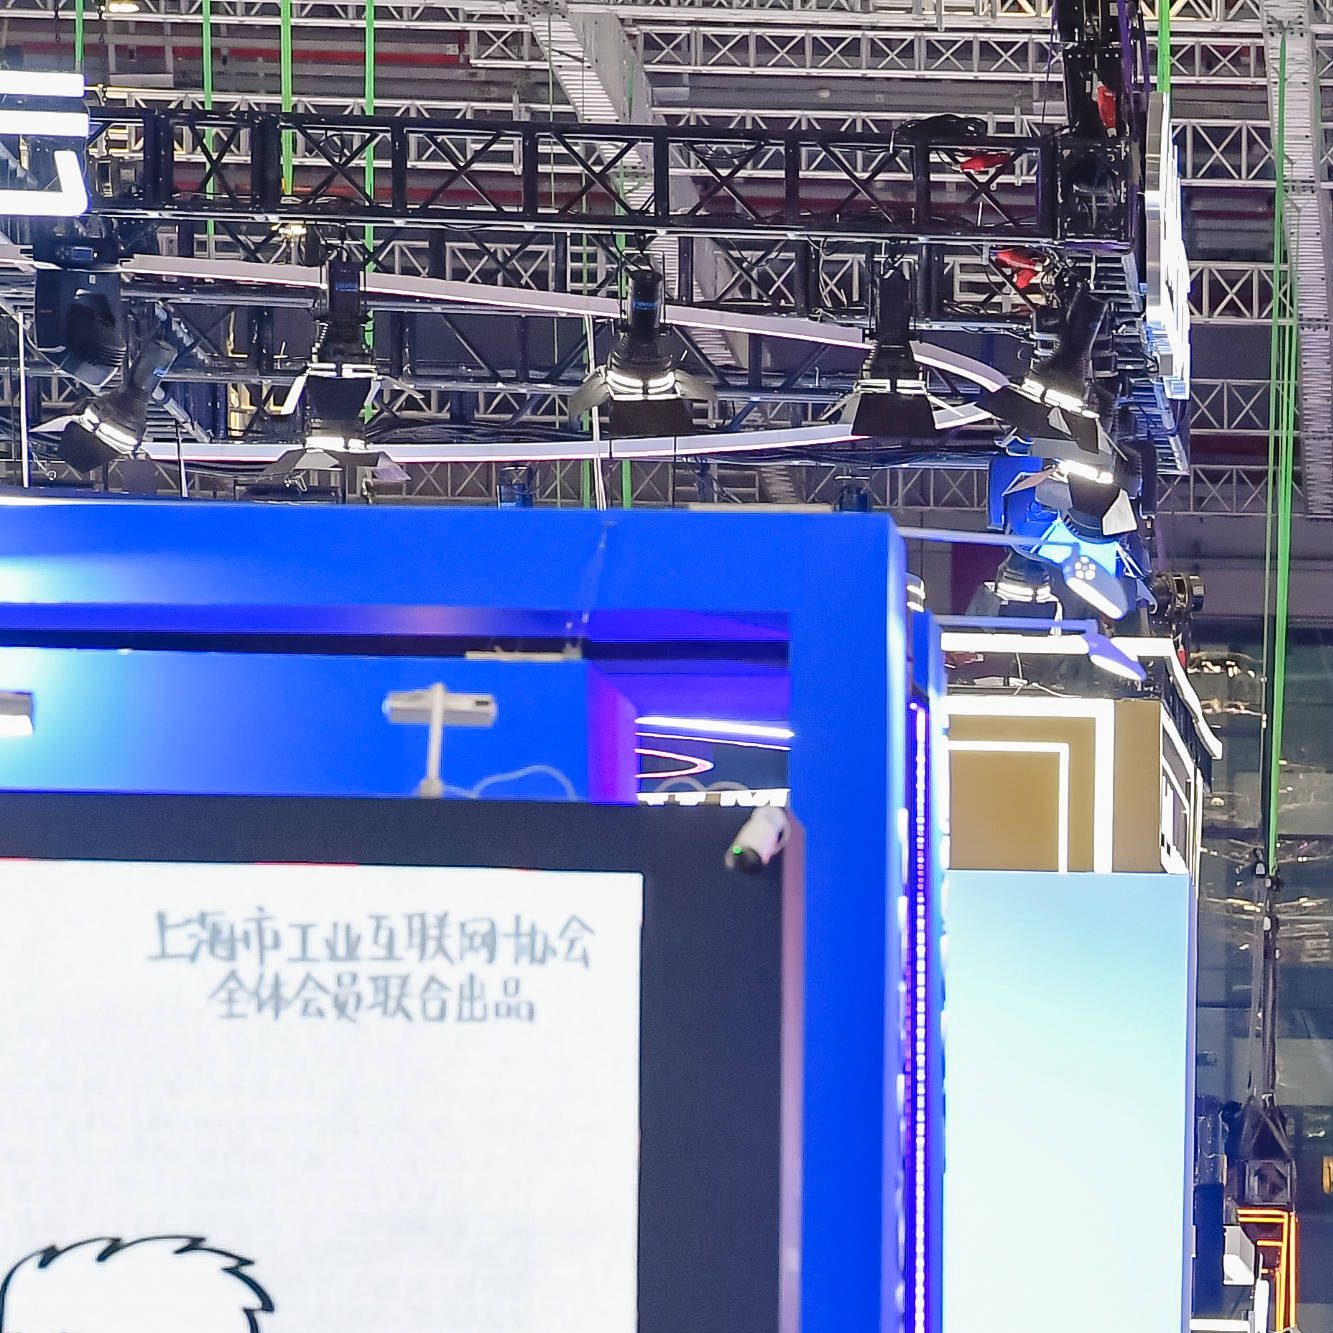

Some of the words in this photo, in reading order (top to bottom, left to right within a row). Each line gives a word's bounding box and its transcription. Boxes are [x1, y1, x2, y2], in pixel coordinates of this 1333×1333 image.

[147, 906, 596, 969] 上海市工业互联网协会
[208, 968, 536, 1023] 全体会员联合出品
